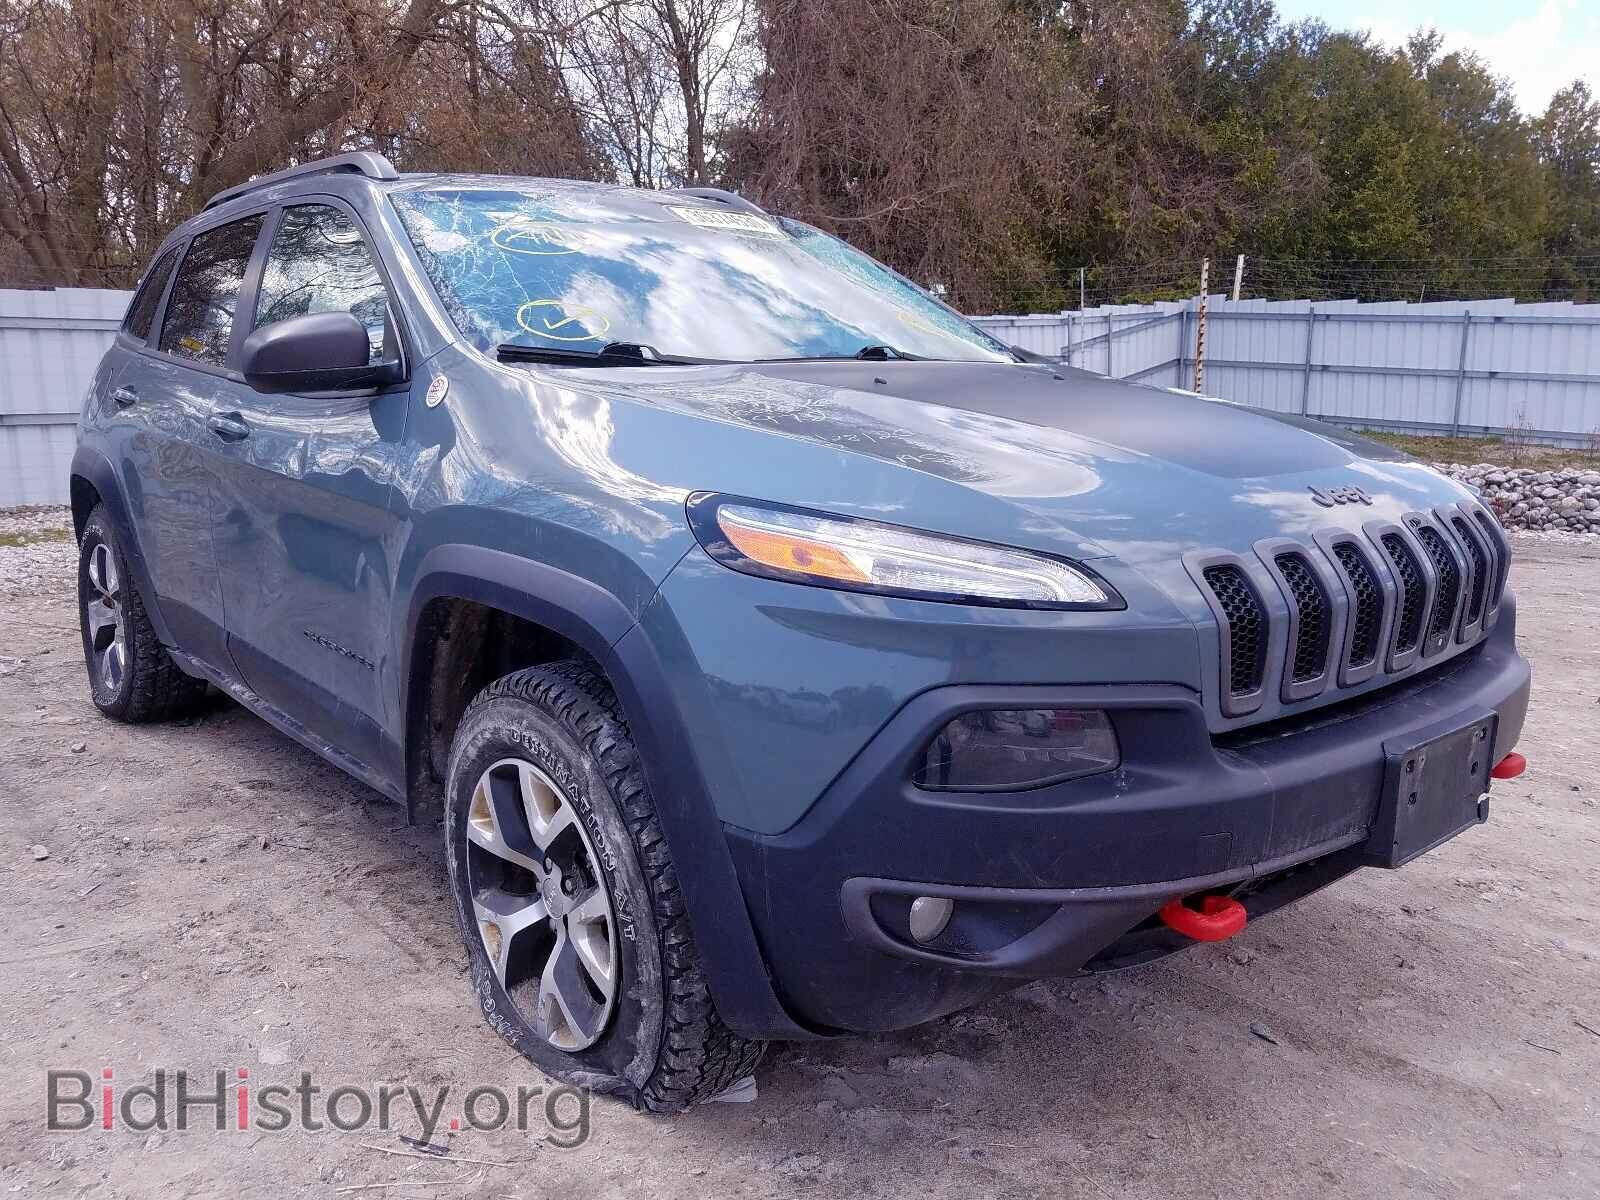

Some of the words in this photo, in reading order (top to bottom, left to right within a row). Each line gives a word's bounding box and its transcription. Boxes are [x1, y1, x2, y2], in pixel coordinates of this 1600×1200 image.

[1307, 485, 1374, 508] Jeep
[511, 728, 616, 872] DESTINATION
[614, 890, 636, 942] A/T
